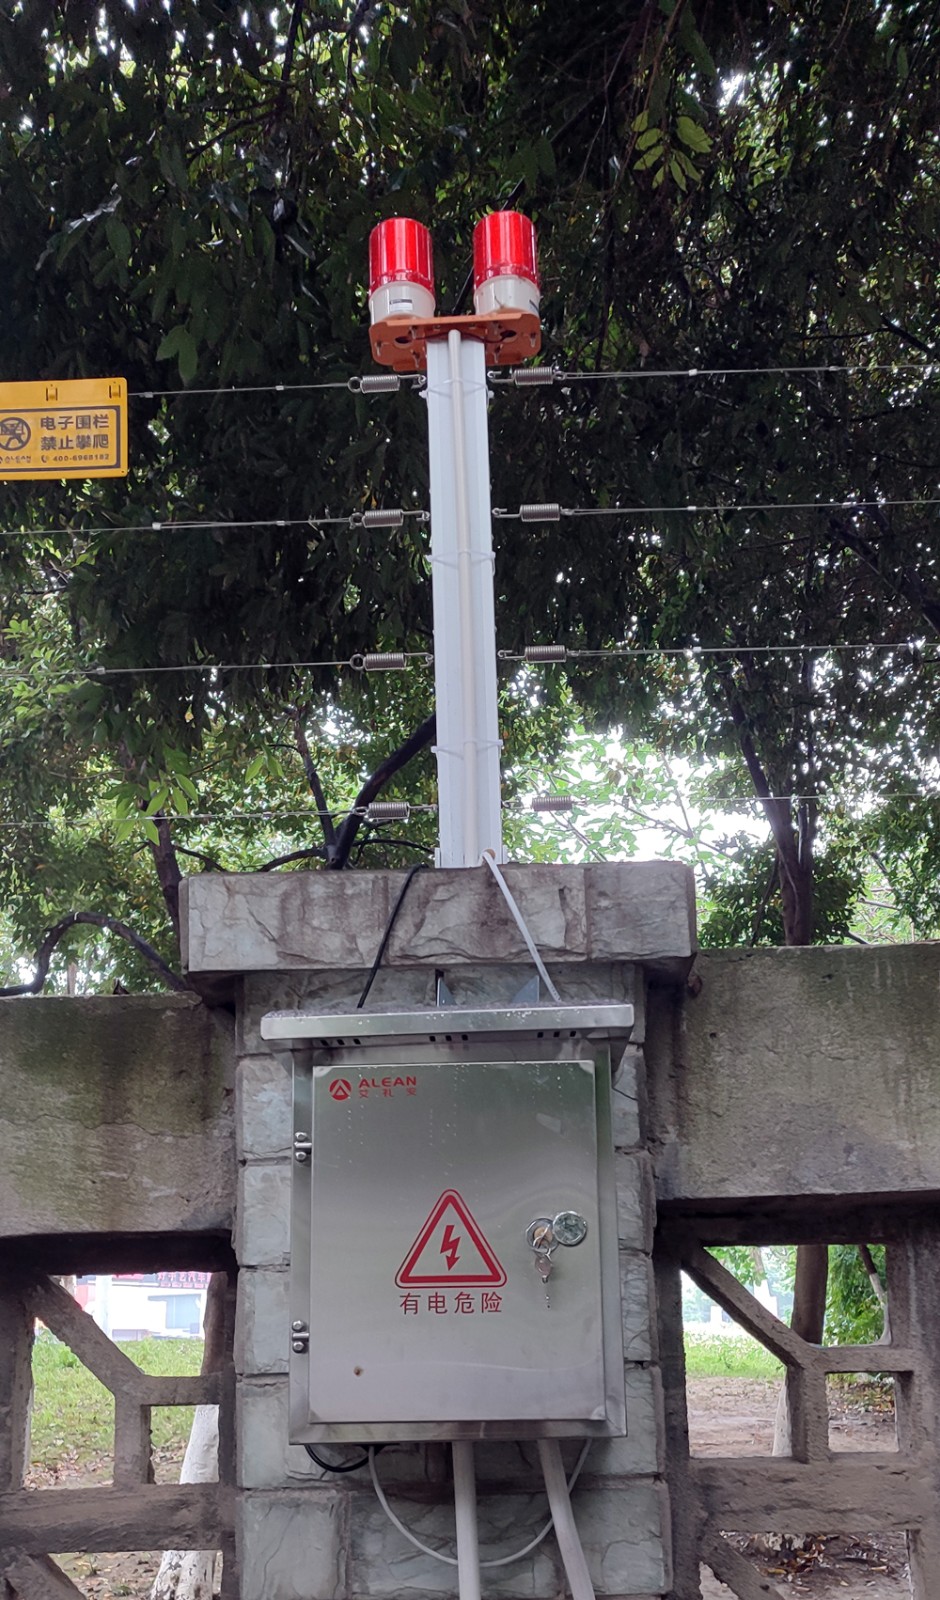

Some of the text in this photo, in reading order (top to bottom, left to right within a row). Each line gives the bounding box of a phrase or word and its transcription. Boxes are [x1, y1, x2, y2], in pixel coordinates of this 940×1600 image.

[40, 414, 109, 430] 电子围栏
[41, 434, 109, 450] 禁止攀爬
[359, 1076, 417, 1088] ALEAN
[399, 1291, 503, 1315] 有电危险
